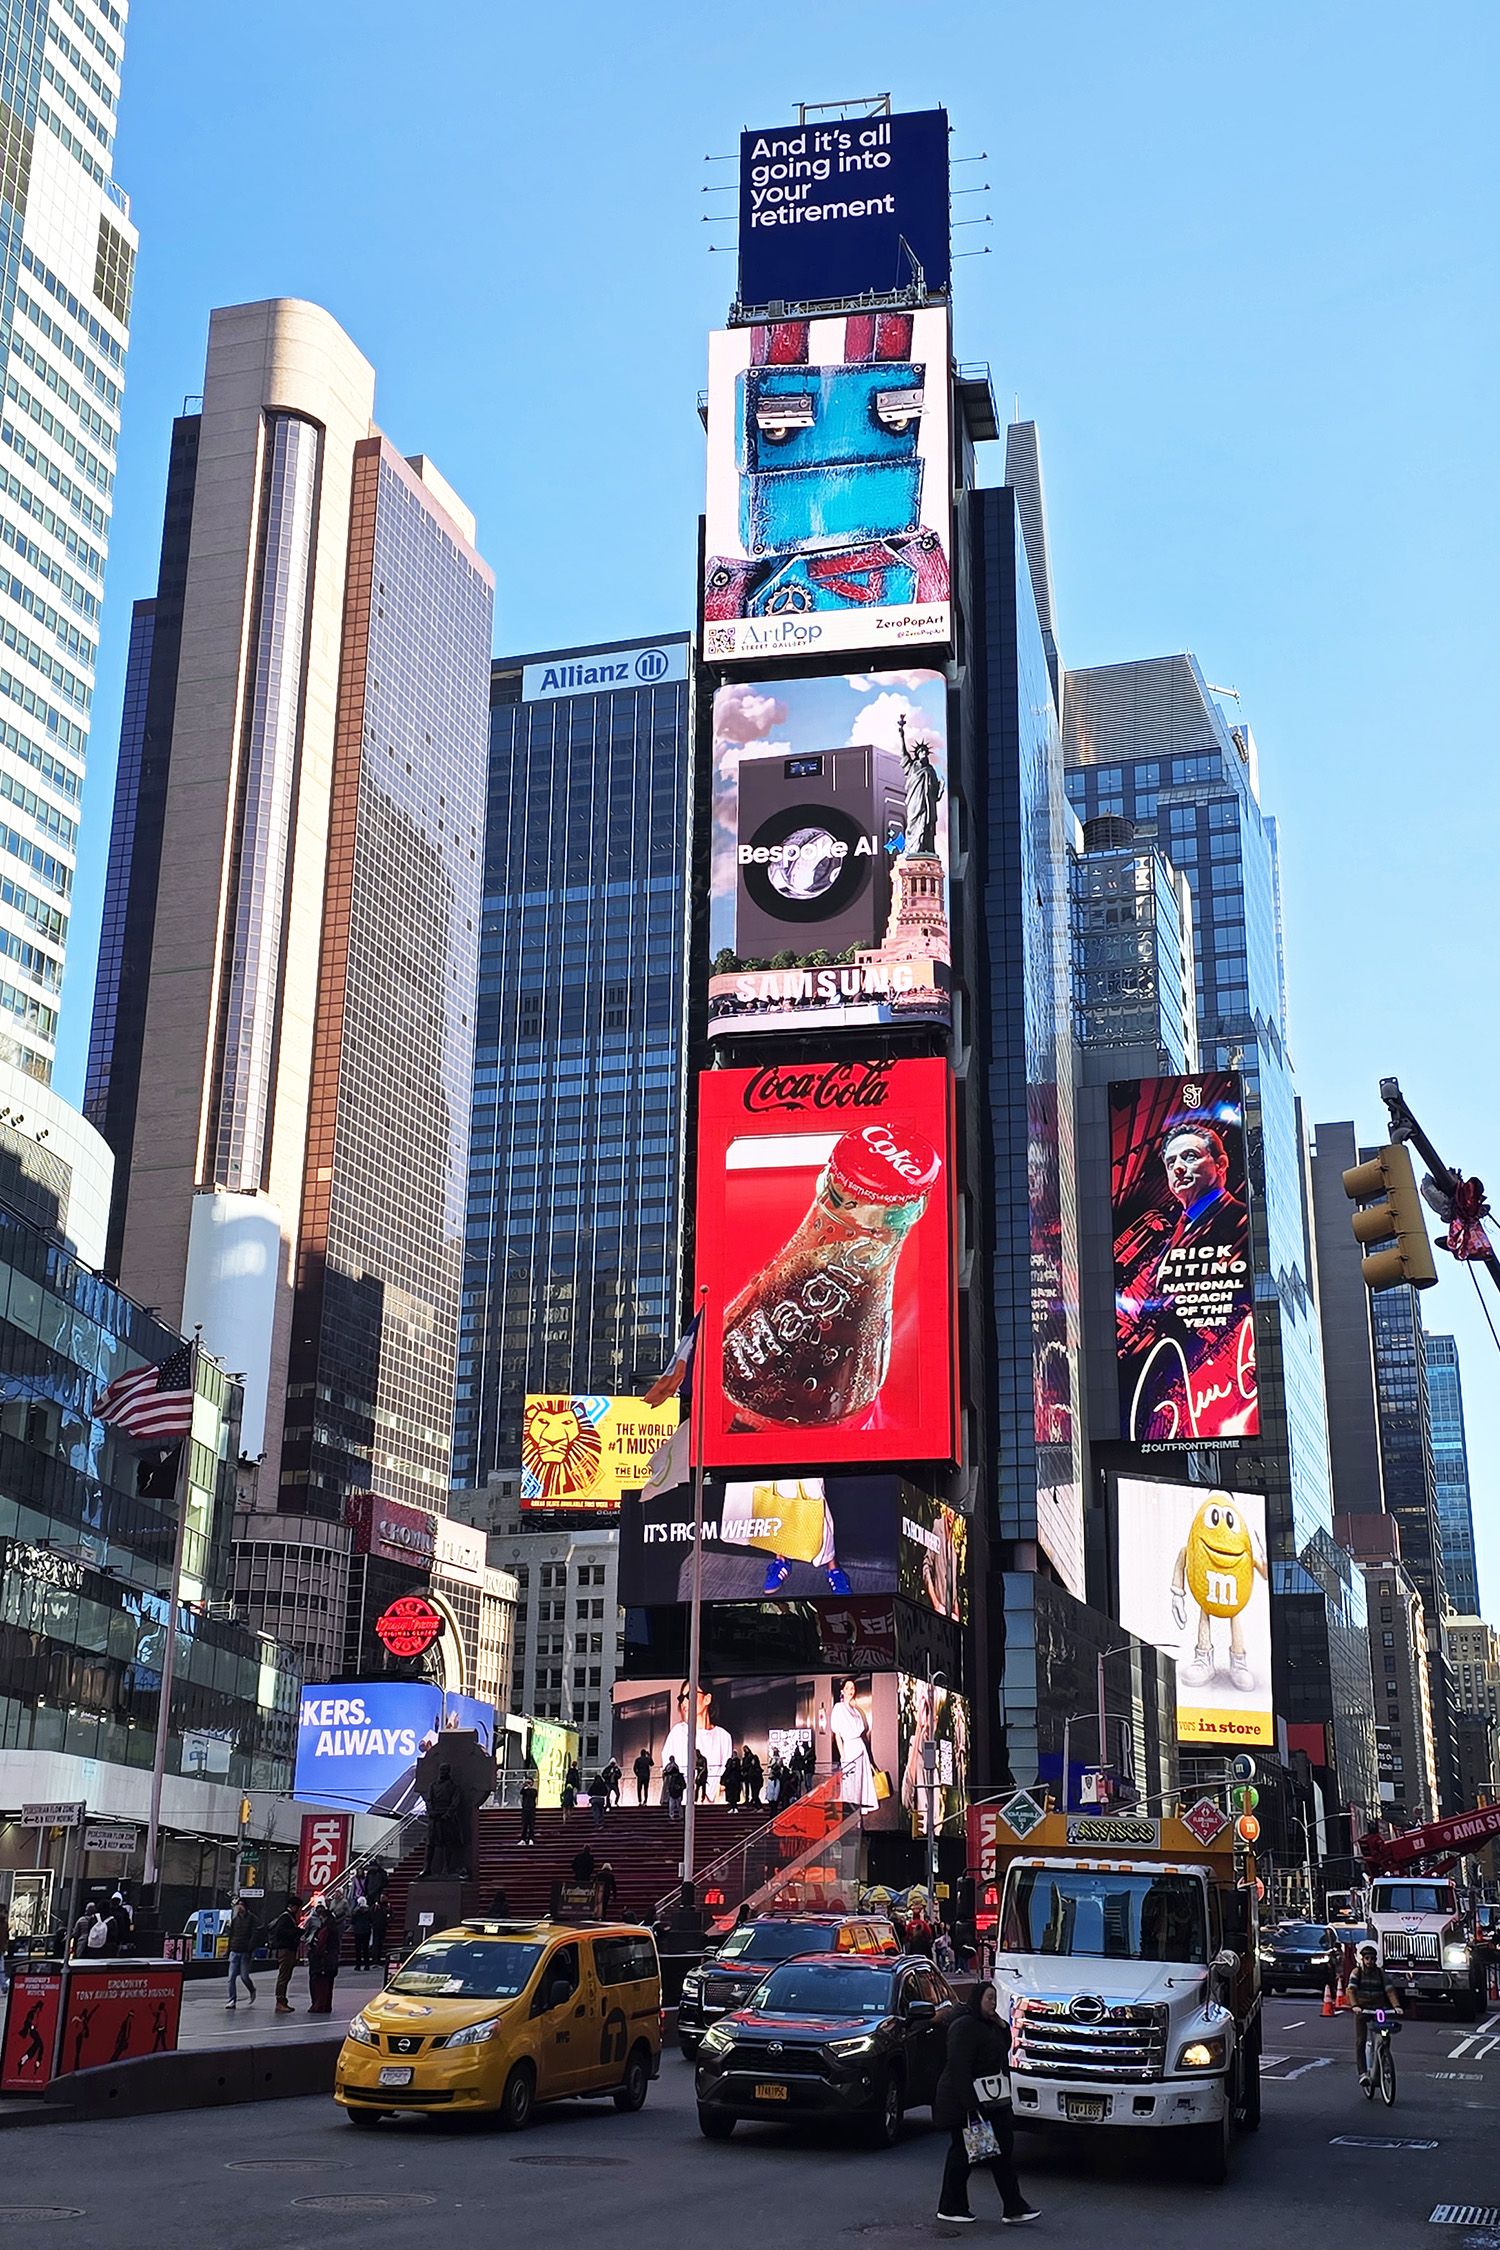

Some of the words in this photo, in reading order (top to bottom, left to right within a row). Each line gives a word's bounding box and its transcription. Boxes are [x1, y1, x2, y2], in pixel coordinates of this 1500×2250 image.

[751, 133, 806, 160] And
[814, 128, 851, 153] it's
[859, 122, 891, 147] all
[751, 156, 830, 187] going
[838, 149, 891, 172] into
[750, 182, 812, 210] your
[750, 193, 895, 228] retirement
[743, 621, 822, 644] ArtPop
[876, 615, 944, 629] ZeroPopArt
[741, 643, 768, 651] STREET
[541, 662, 629, 691] Allianz
[738, 839, 848, 865] Bespoke
[854, 835, 878, 856] AI
[736, 966, 913, 1000] SAMSUNG
[744, 1060, 897, 1112] Coca-Cola
[862, 1126, 921, 1182] Coke
[1170, 1244, 1233, 1261] RICK
[1158, 1261, 1247, 1279] PITINO
[1162, 1279, 1244, 1293] NATIONAL
[1175, 1292, 1233, 1304] COACH
[1175, 1305, 1198, 1316] OF
[1201, 1303, 1233, 1315] THE
[1183, 1317, 1227, 1328] YEAR
[616, 1423, 635, 1435] THE
[609, 1438, 622, 1454] #1
[1141, 1440, 1240, 1453] #OUTFRONTPRIME
[615, 1467, 631, 1475] THE
[643, 1523, 668, 1543] IT'S
[719, 1517, 782, 1541] WHERE?
[1205, 1570, 1239, 1606] m
[1198, 1718, 1217, 1733] in
[1219, 1719, 1261, 1735] store
[315, 1728, 416, 1757] ALWAYS
[1453, 1818, 1486, 1840] AMA
[308, 1819, 340, 1889] tkts
